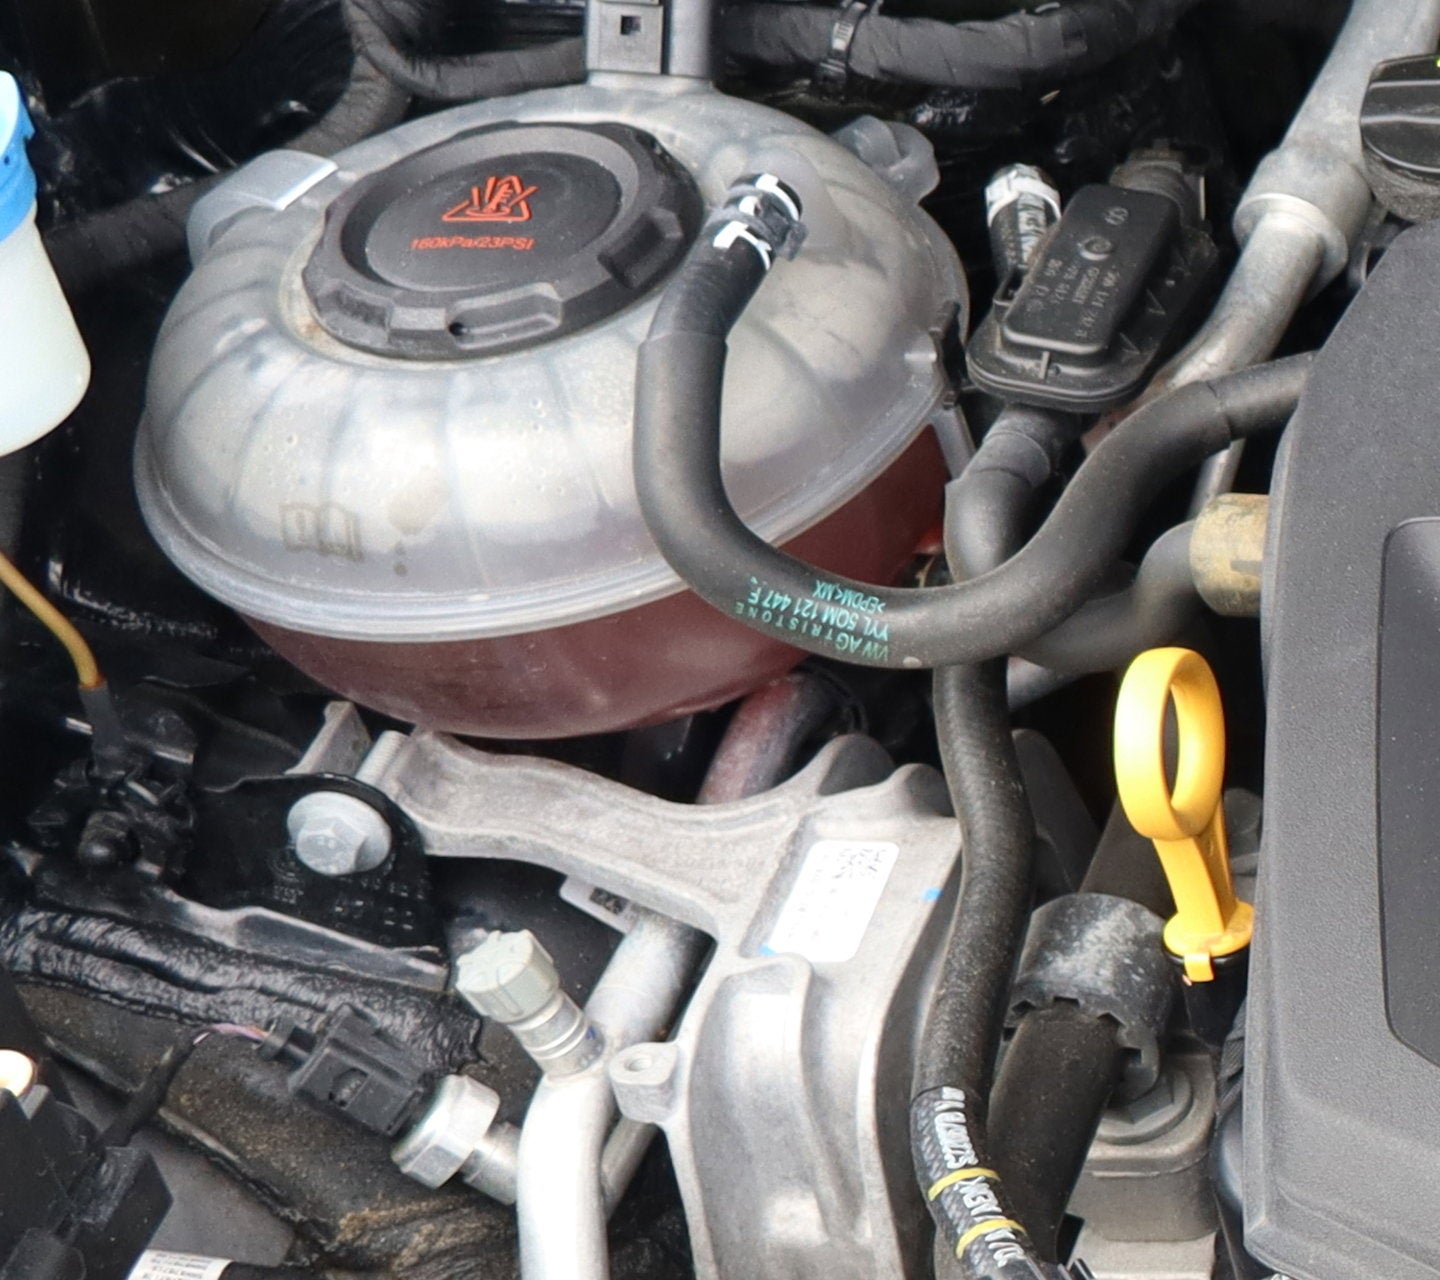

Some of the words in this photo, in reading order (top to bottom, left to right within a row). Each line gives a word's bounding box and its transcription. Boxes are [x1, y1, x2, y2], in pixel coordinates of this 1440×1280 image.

[762, 589, 792, 611] 447
[794, 597, 820, 619] 121
[863, 621, 889, 641] YYL
[835, 633, 862, 653] AG
[862, 640, 889, 661] VW
